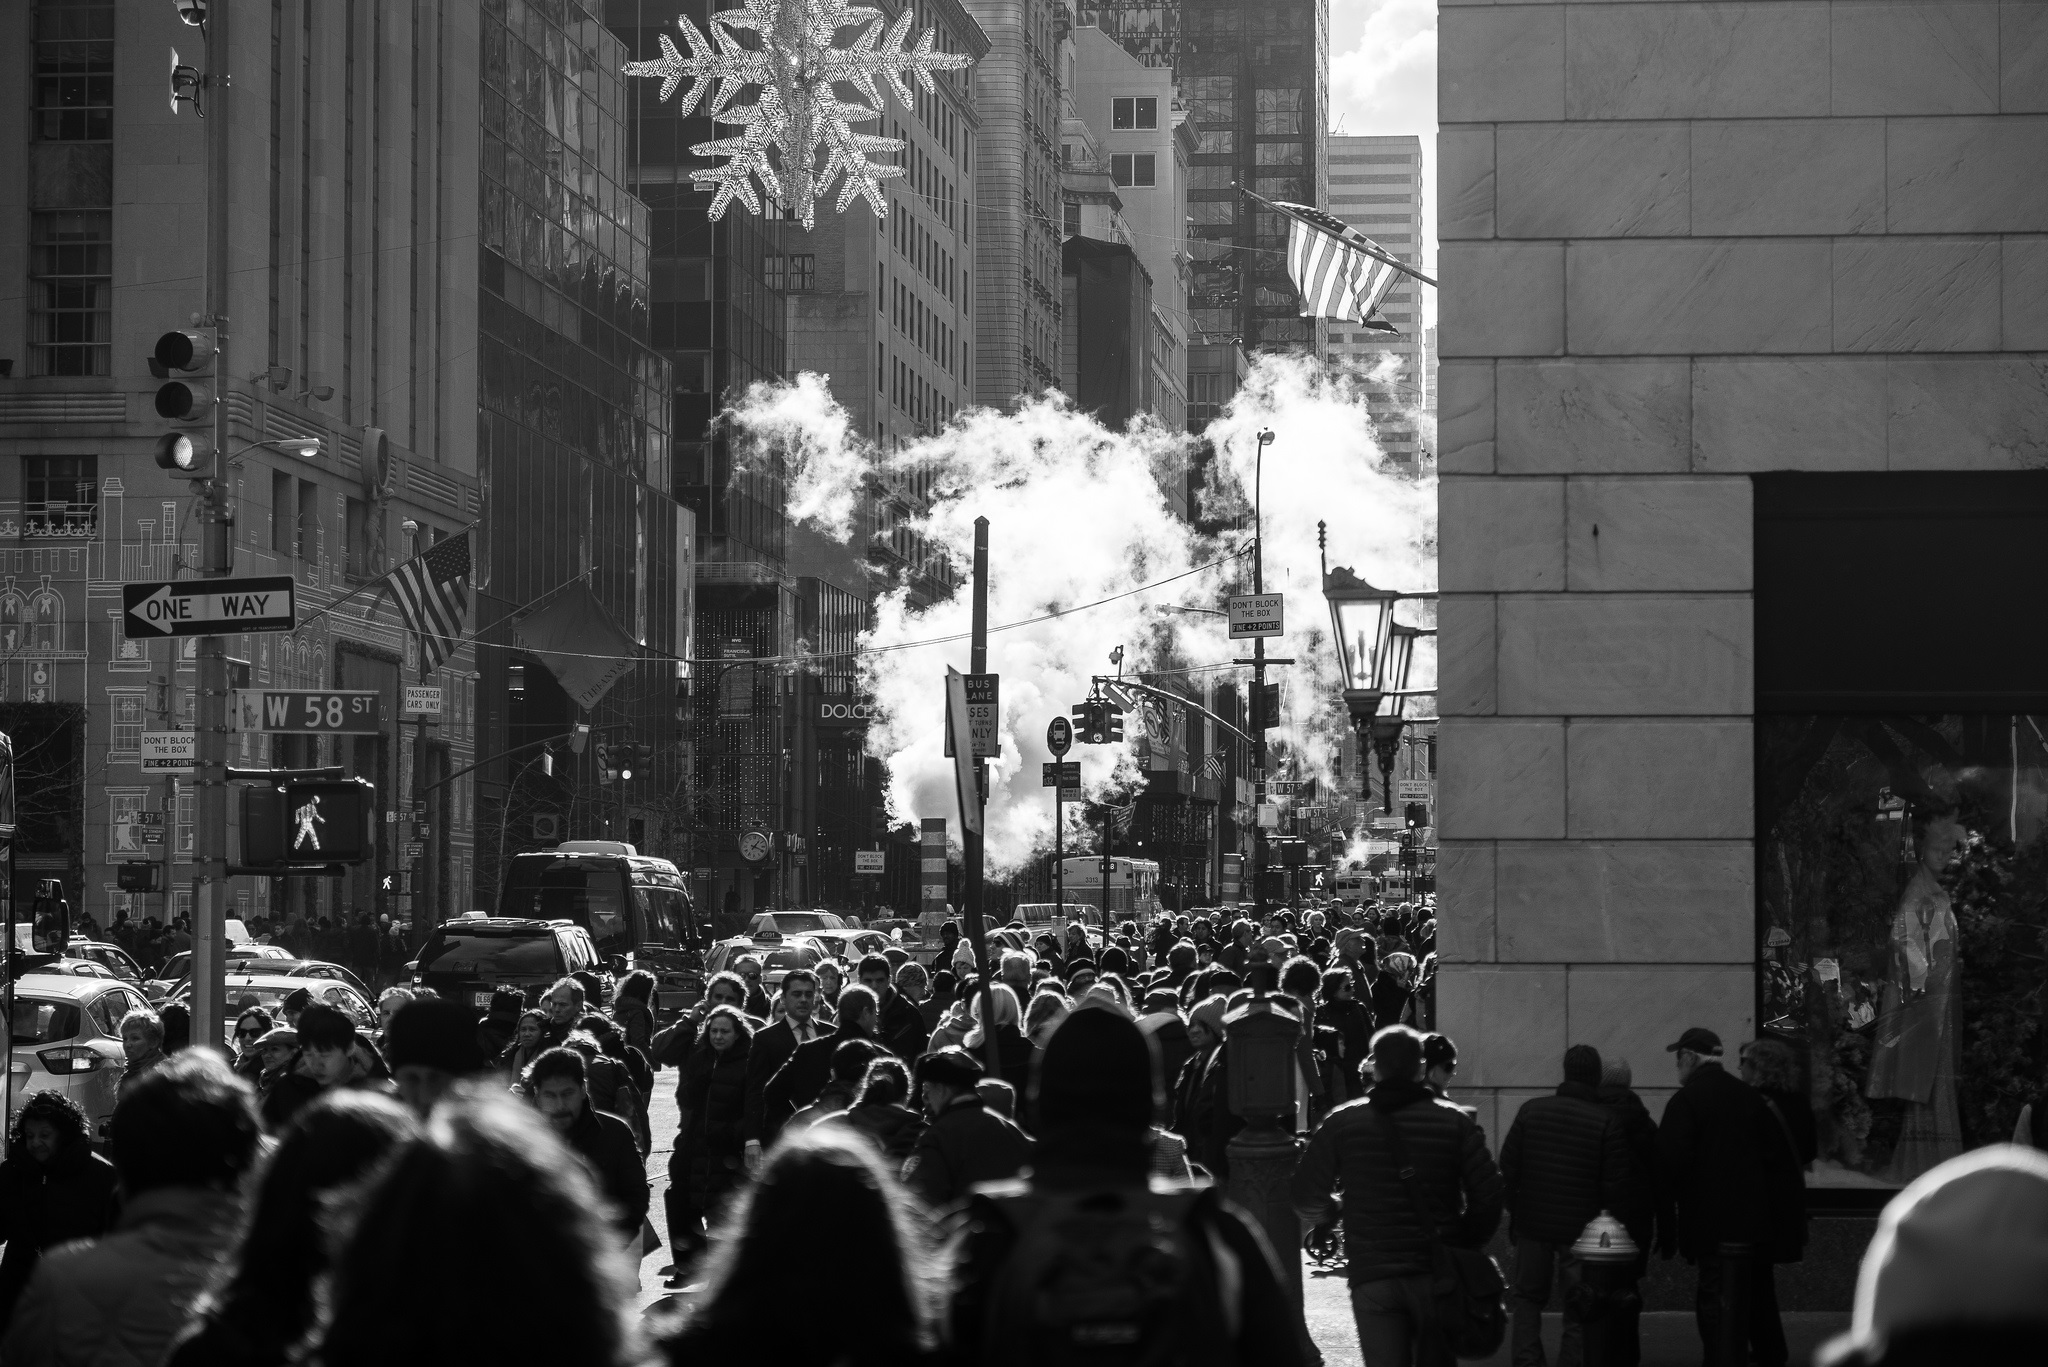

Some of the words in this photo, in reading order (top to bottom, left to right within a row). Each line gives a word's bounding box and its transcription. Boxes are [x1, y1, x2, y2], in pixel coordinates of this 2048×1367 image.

[146, 598, 192, 621] ONE
[221, 594, 269, 617] WAY
[1233, 601, 1253, 609] DON'T
[1255, 599, 1279, 608] BLOCK
[1241, 610, 1254, 618] THE
[1257, 609, 1271, 617] BOX
[579, 668, 617, 702] TIFFANY
[967, 680, 990, 689] BUS
[407, 690, 440, 699] PASSENGER
[407, 700, 422, 709] CARS
[426, 700, 440, 709] ONLY
[266, 696, 289, 727] W
[304, 696, 343, 728] 58
[351, 697, 373, 713] ST
[821, 704, 872, 719] DOLCE
[972, 728, 992, 738] NLY
[1277, 784, 1284, 793] W
[1286, 784, 1295, 794] 57
[400, 813, 407, 822] 57
[1305, 809, 1312, 817] W
[1313, 809, 1320, 817] 57
[145, 813, 154, 824] 57
